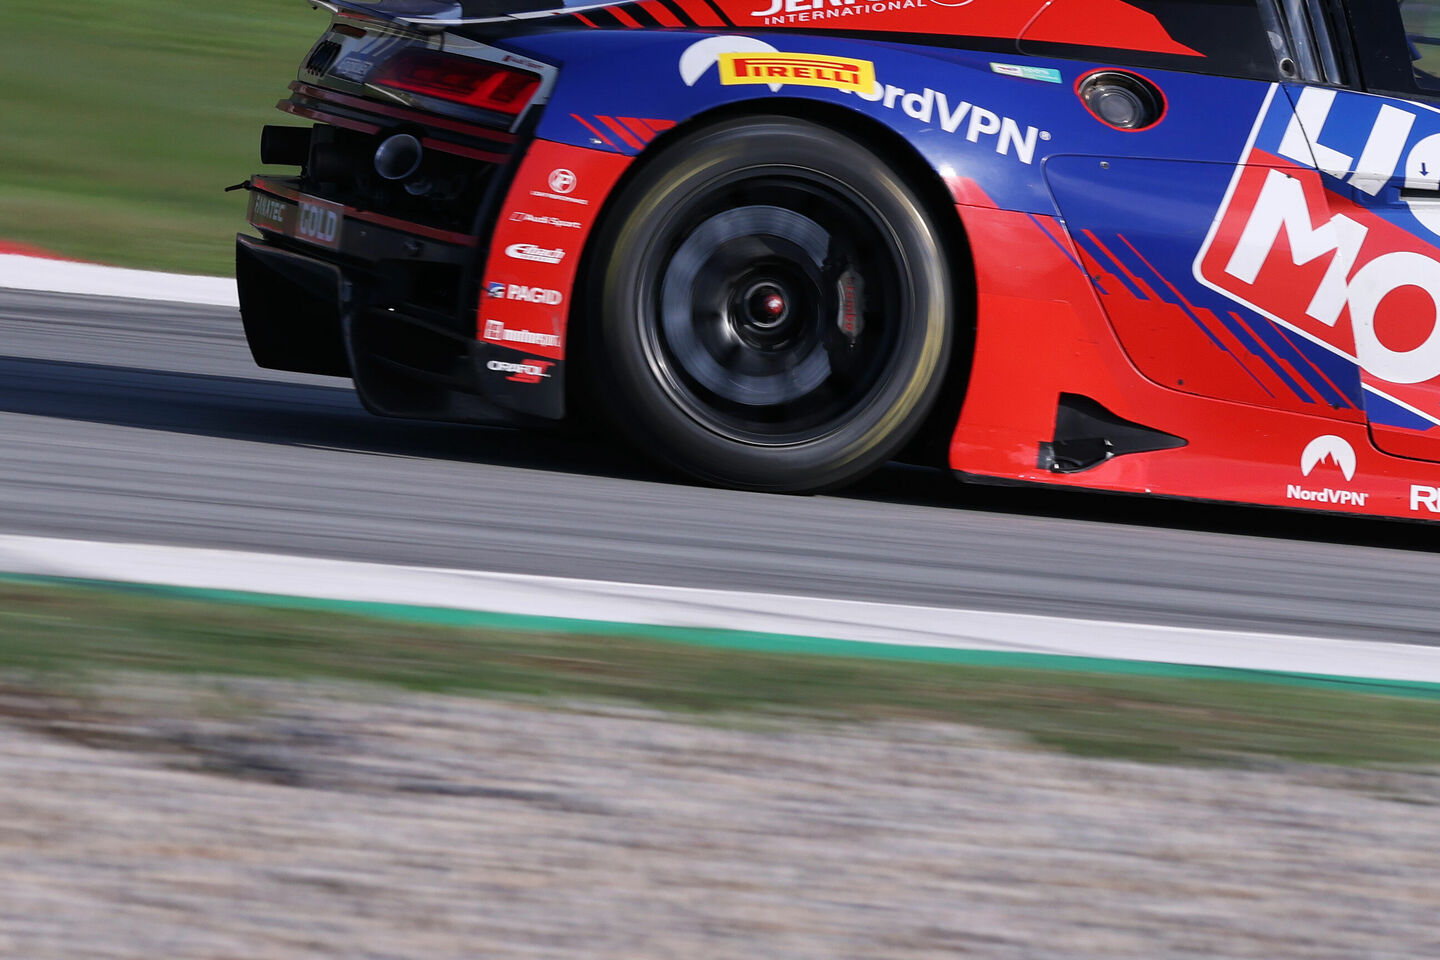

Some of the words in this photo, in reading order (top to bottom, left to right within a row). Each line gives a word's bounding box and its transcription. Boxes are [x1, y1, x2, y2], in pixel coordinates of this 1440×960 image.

[734, 57, 861, 86] PIRELLI
[300, 203, 337, 242] GOLD
[507, 284, 563, 306] PAGID
